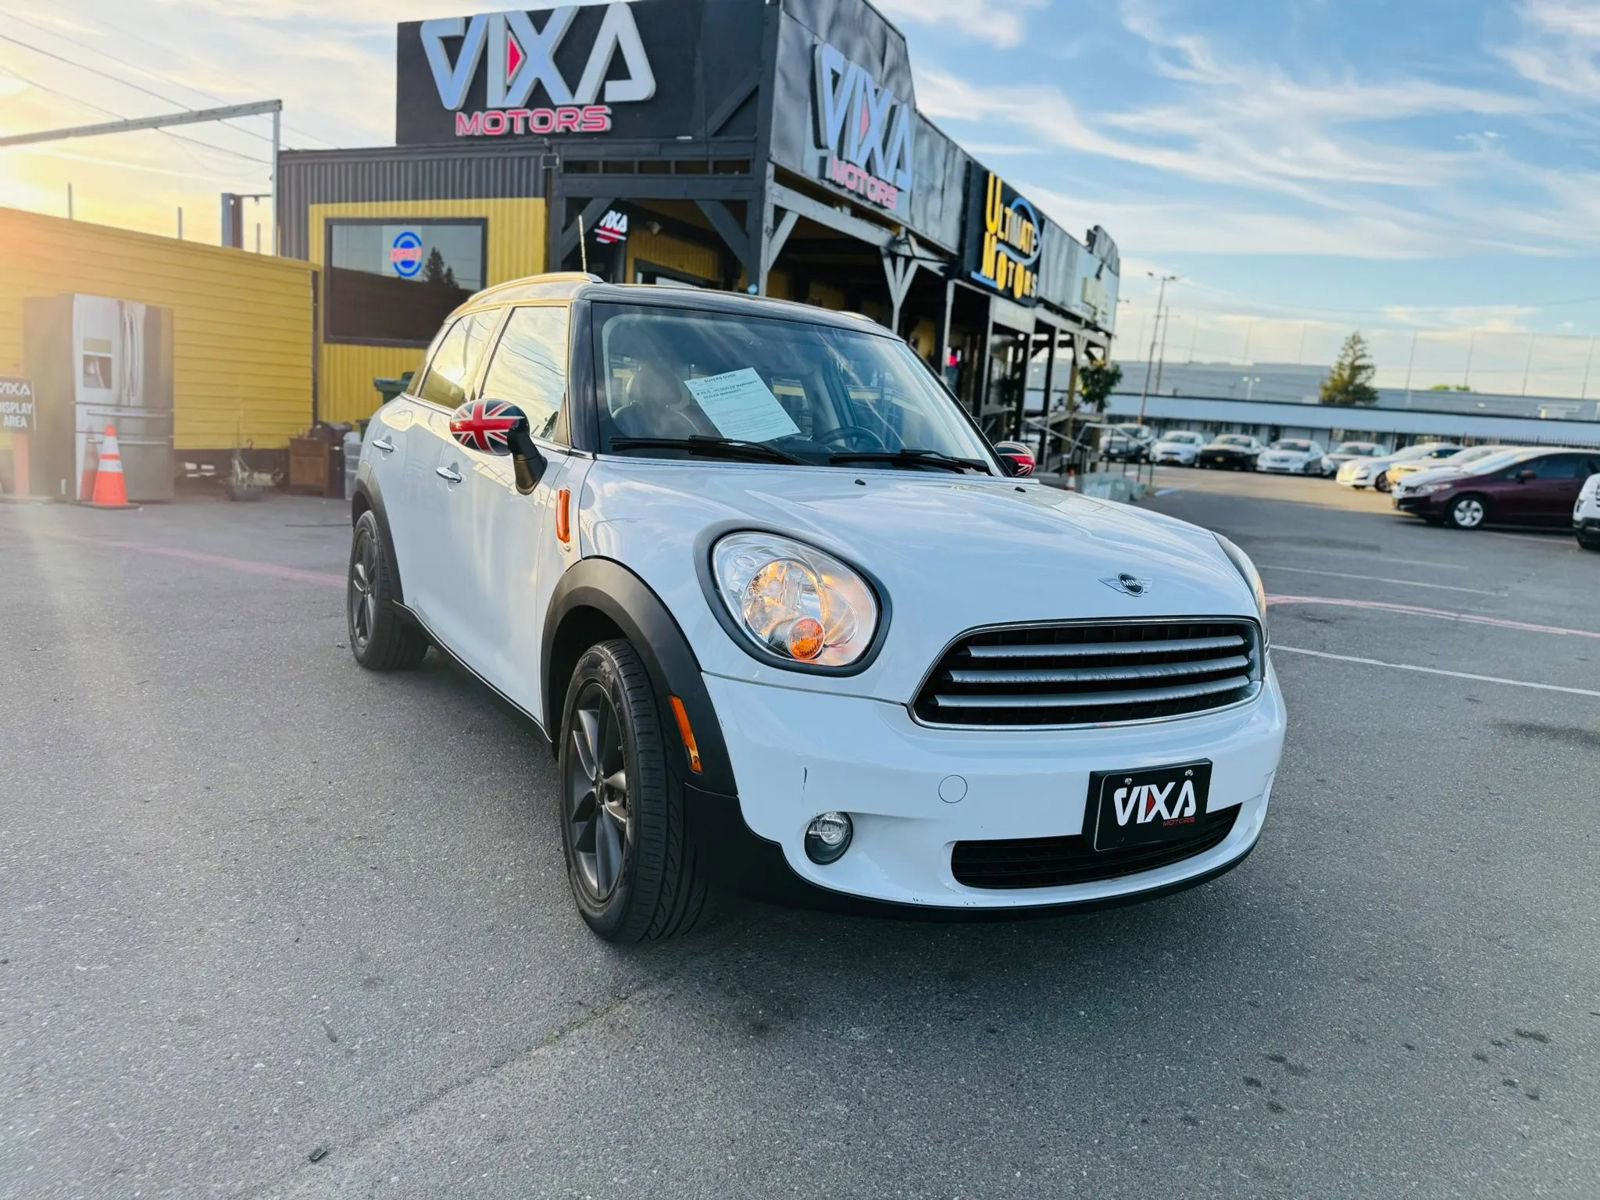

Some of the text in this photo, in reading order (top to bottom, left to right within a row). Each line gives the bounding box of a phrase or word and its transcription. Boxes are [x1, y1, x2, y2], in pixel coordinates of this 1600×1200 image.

[420, 2, 656, 110] VIXA
[455, 105, 612, 136] MOTORS
[817, 43, 913, 192] VIXA
[832, 156, 898, 210] MOTORS
[981, 231, 1038, 298] MOTORS
[1113, 780, 1197, 827] VIXA
[1162, 816, 1196, 827] MOTORS
